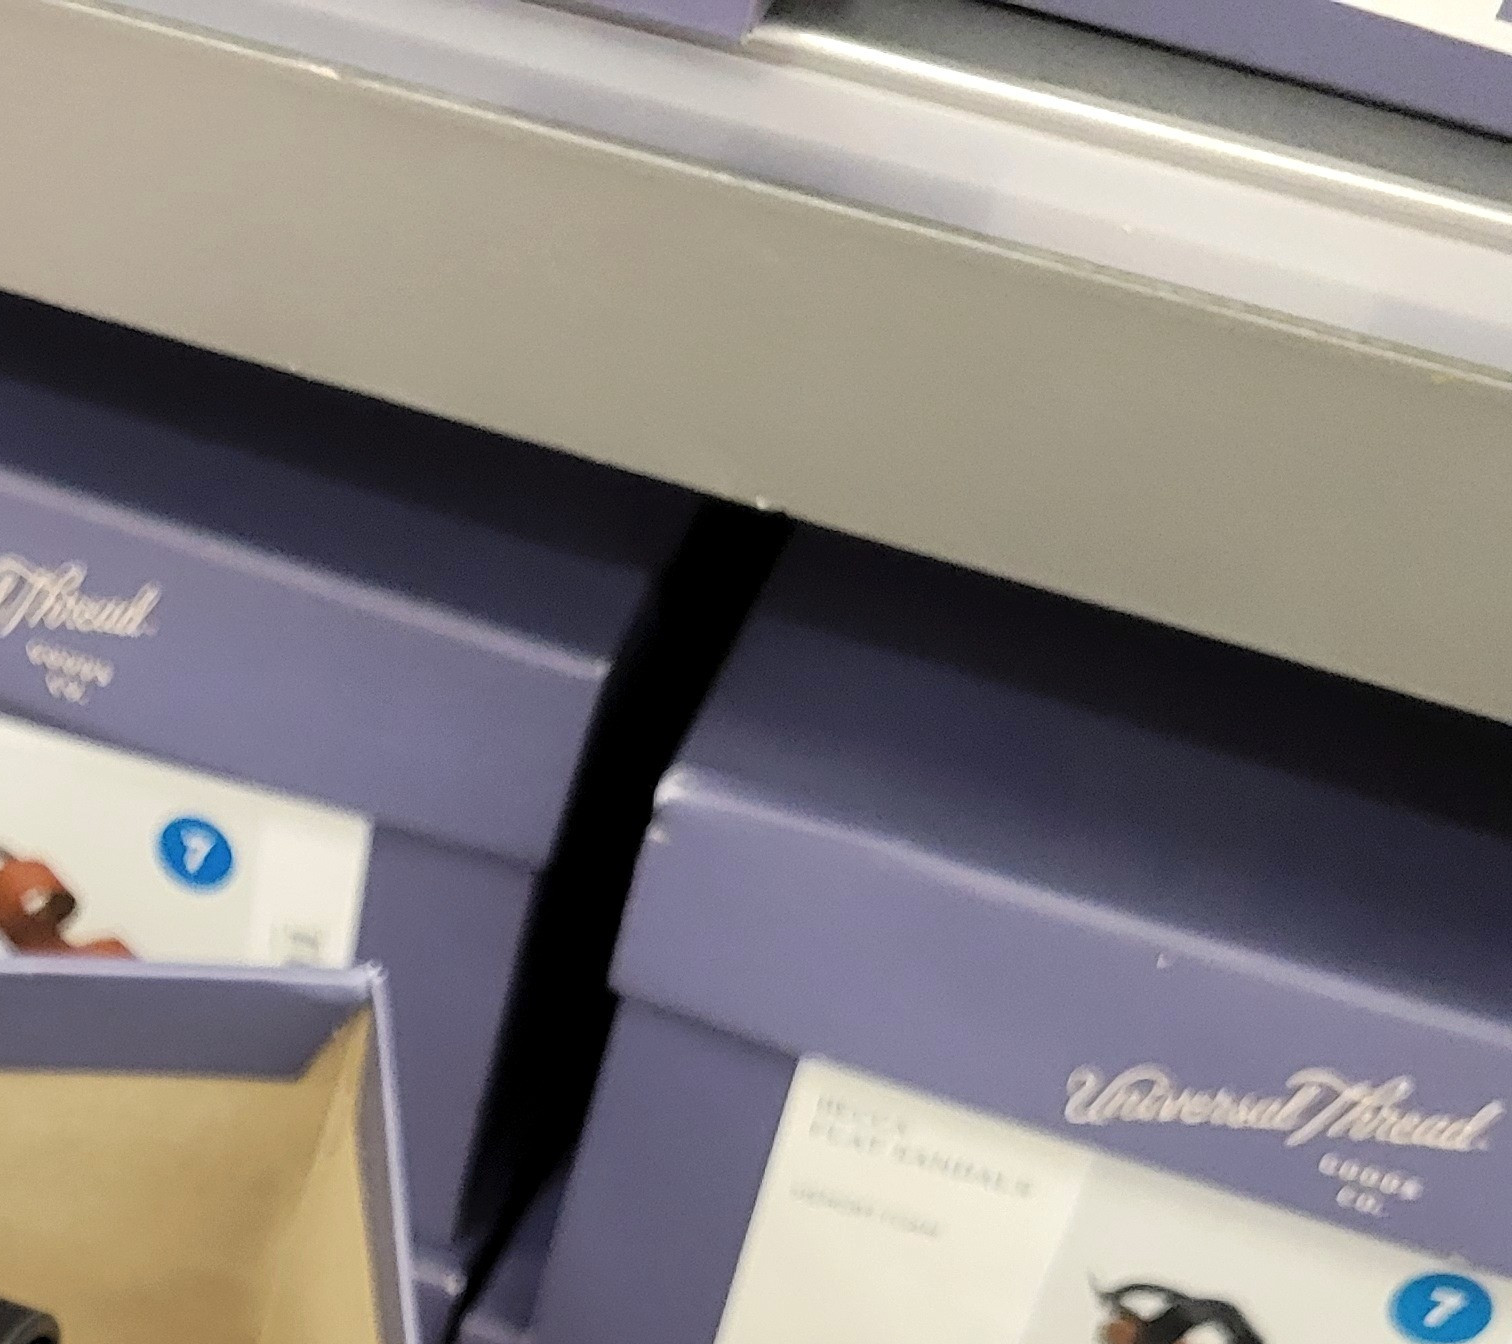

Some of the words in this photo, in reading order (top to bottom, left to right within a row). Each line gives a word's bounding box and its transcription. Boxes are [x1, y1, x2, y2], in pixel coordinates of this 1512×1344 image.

[1065, 1063, 1320, 1132] Universal
[1287, 1067, 1504, 1151] Thread
[1422, 1285, 1466, 1328] 7
